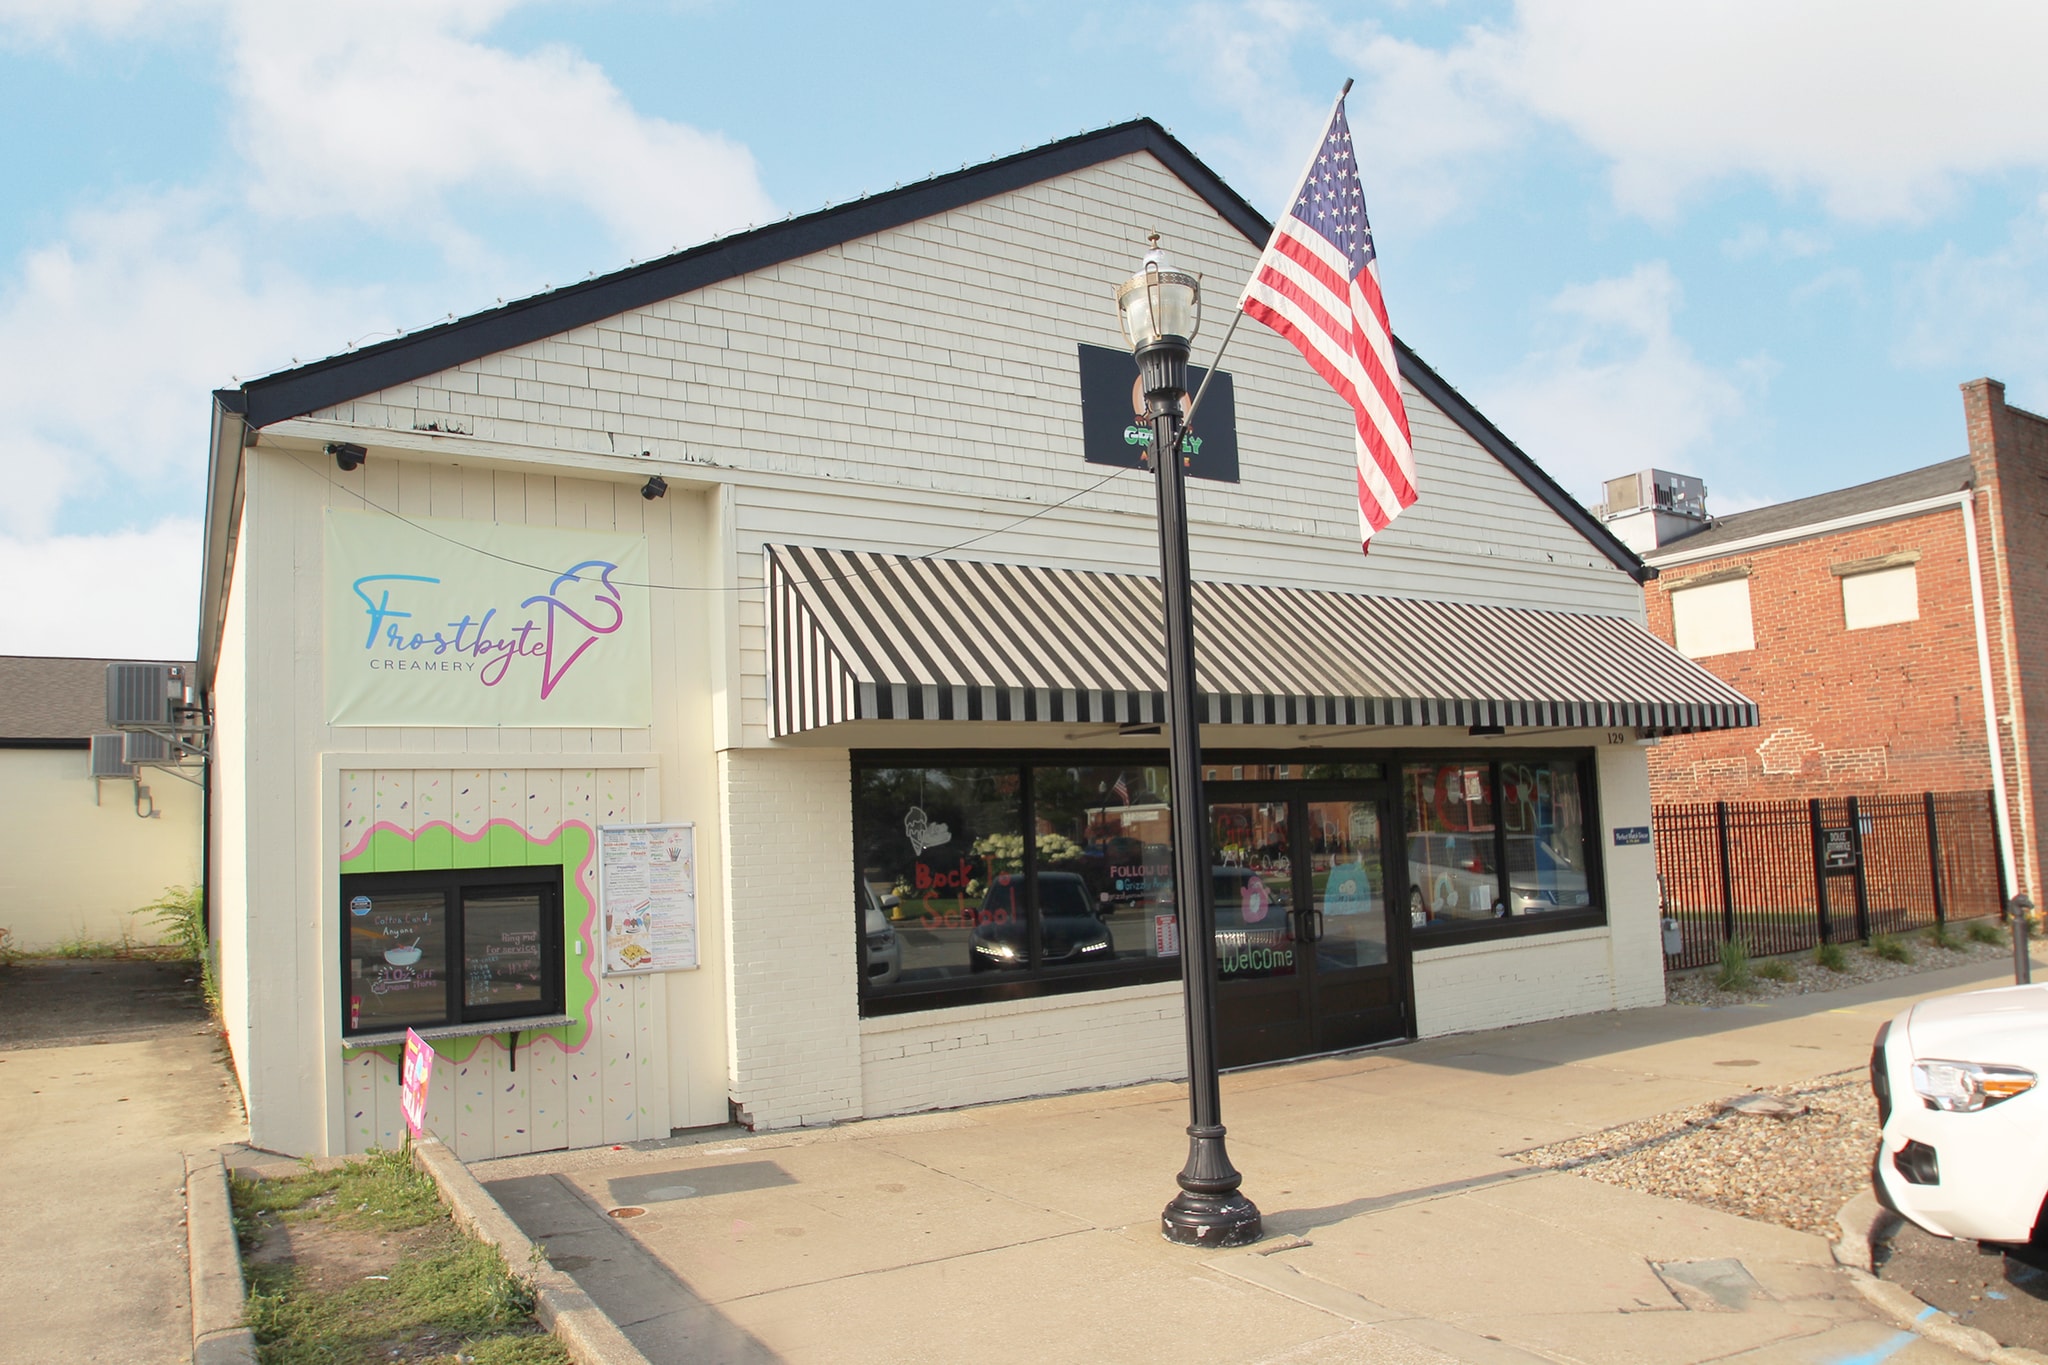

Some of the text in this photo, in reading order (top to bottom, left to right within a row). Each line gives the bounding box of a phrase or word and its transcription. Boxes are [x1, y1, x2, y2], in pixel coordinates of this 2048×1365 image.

[1124, 426, 1203, 455] GRLY
[353, 574, 547, 686] Frostbyte
[369, 659, 475, 671] CREAMERY
[1607, 732, 1624, 744] 129
[1110, 865, 1154, 878] FOLLOW
[921, 887, 1016, 930] School
[1222, 940, 1294, 973] Welcome
[383, 968, 411, 982] 10%
